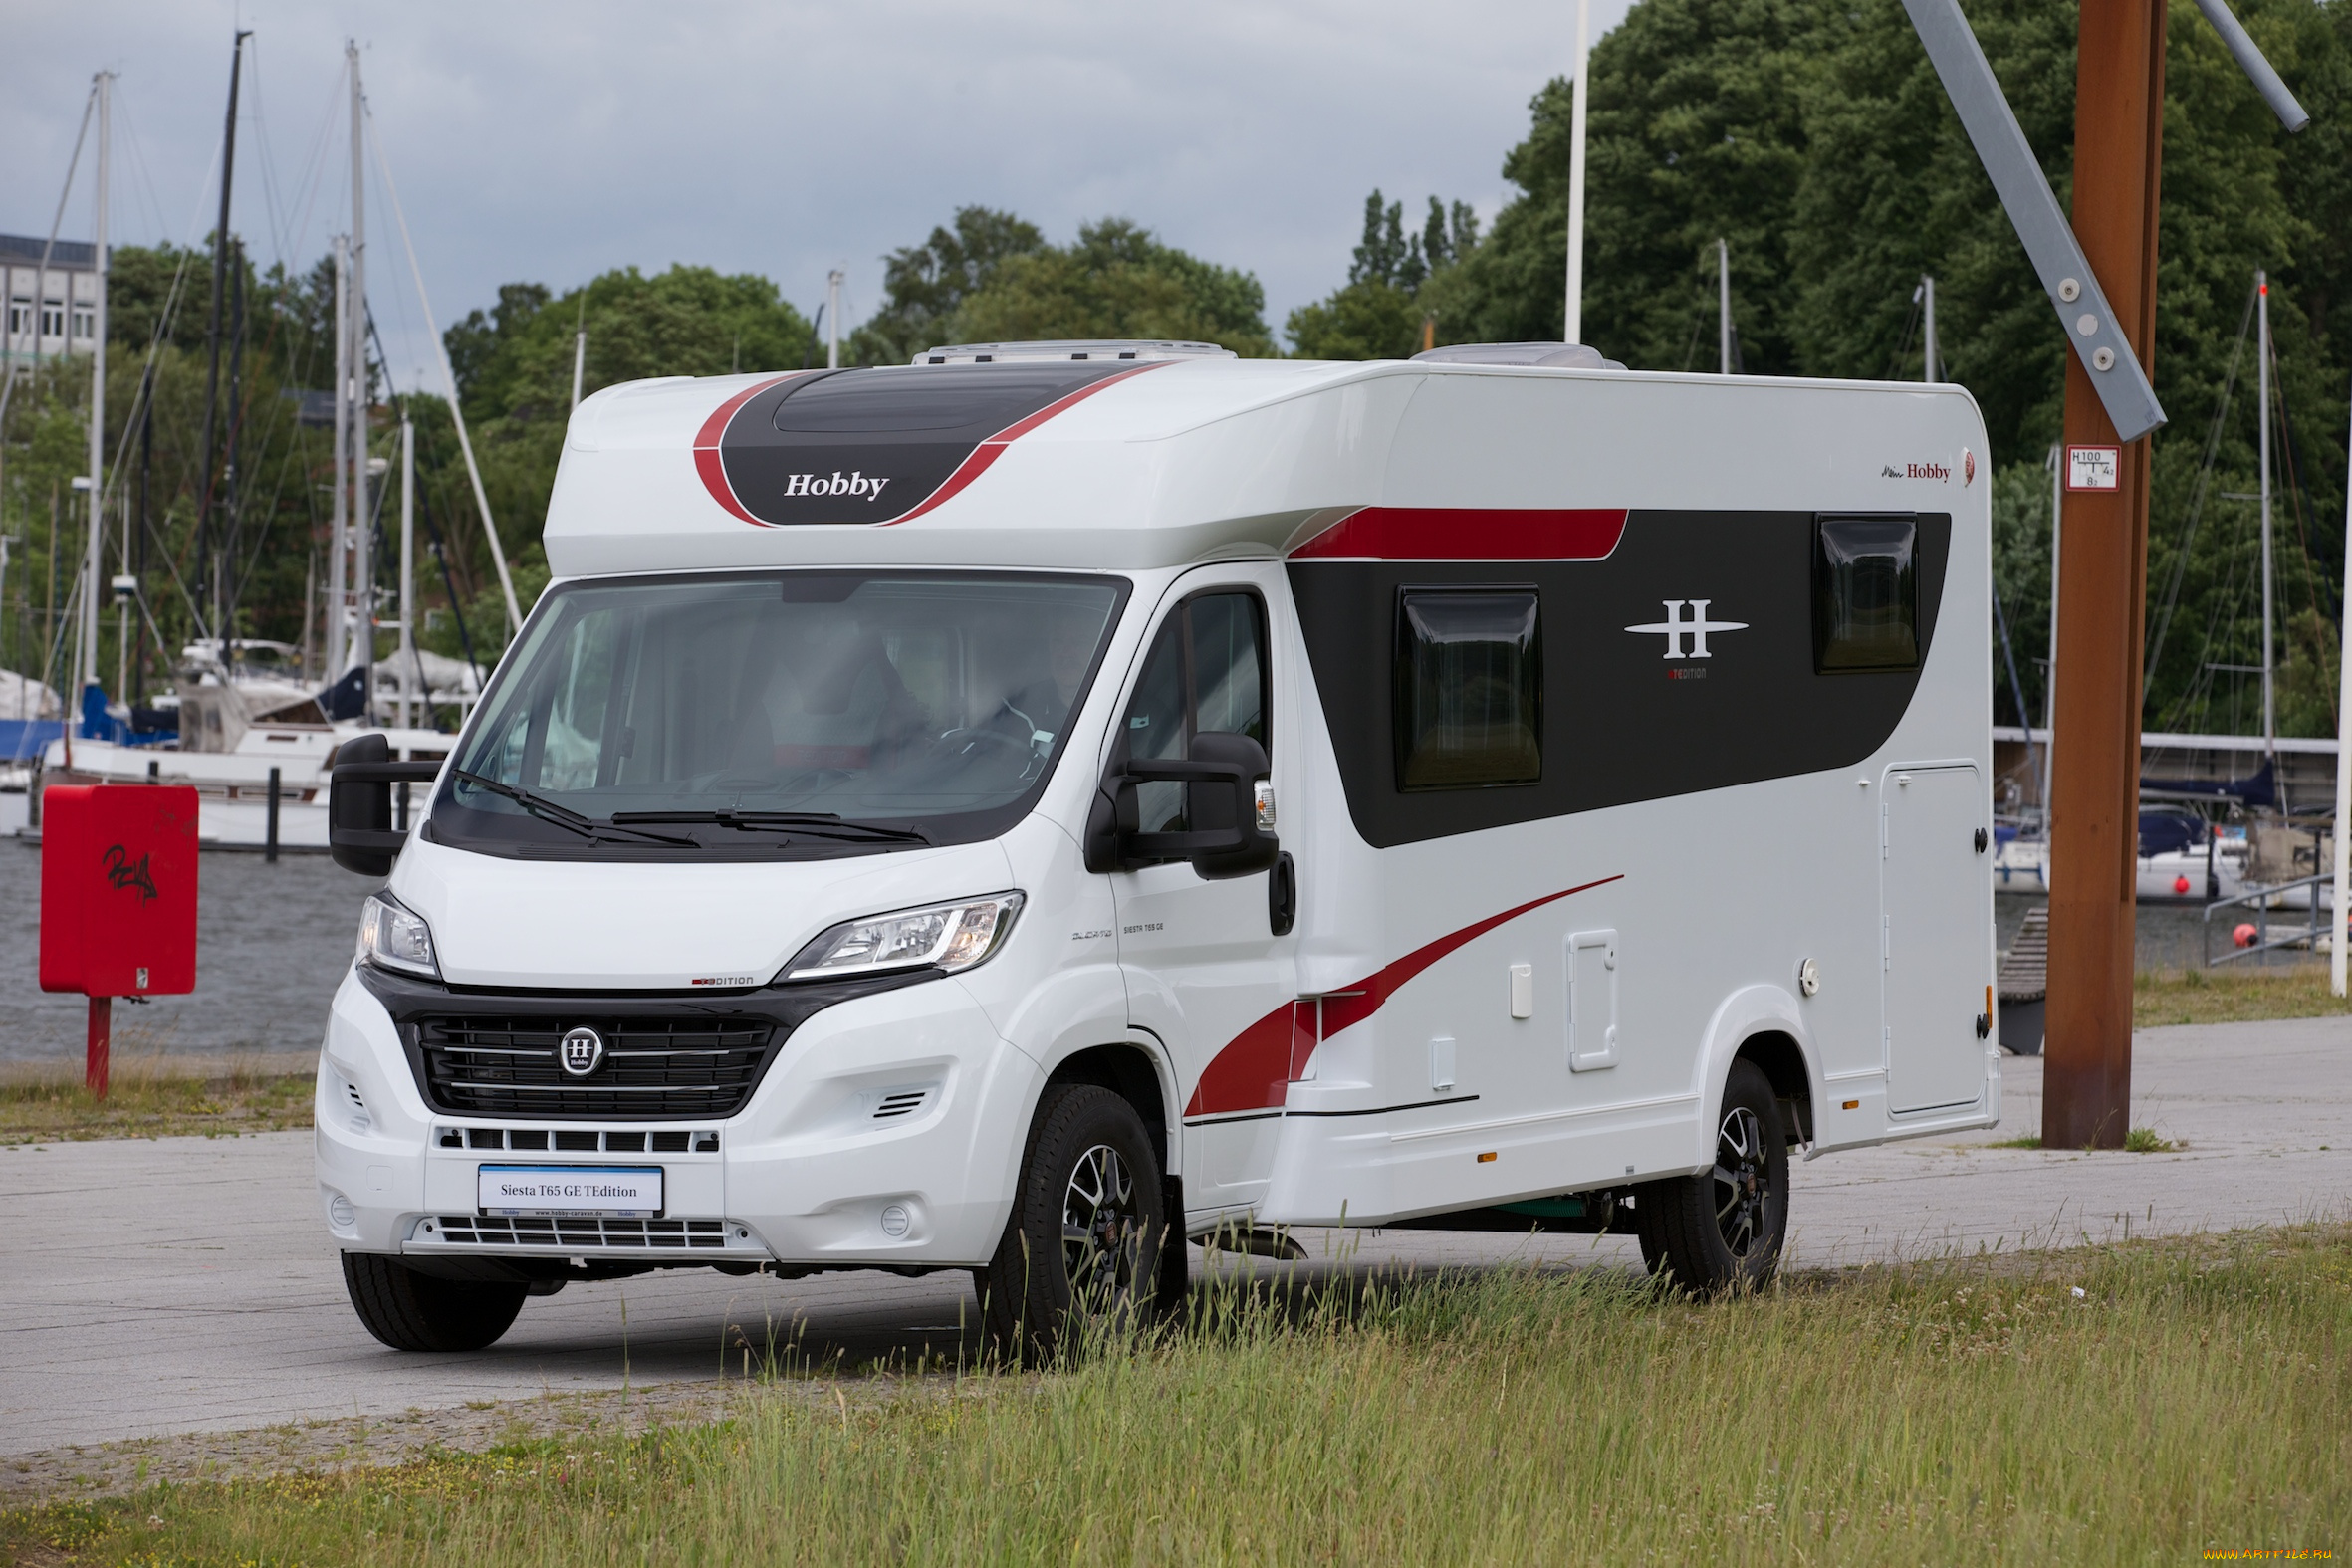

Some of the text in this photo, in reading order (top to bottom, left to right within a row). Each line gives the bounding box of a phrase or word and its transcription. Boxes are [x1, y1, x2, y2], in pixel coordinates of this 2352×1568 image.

[2072, 451, 2101, 461] H100
[1907, 463, 1951, 483] Hobby
[784, 471, 890, 502] Hobby
[1123, 925, 1143, 935] SIESTA
[501, 1184, 637, 1198] Siesta T65 GE TEdition
